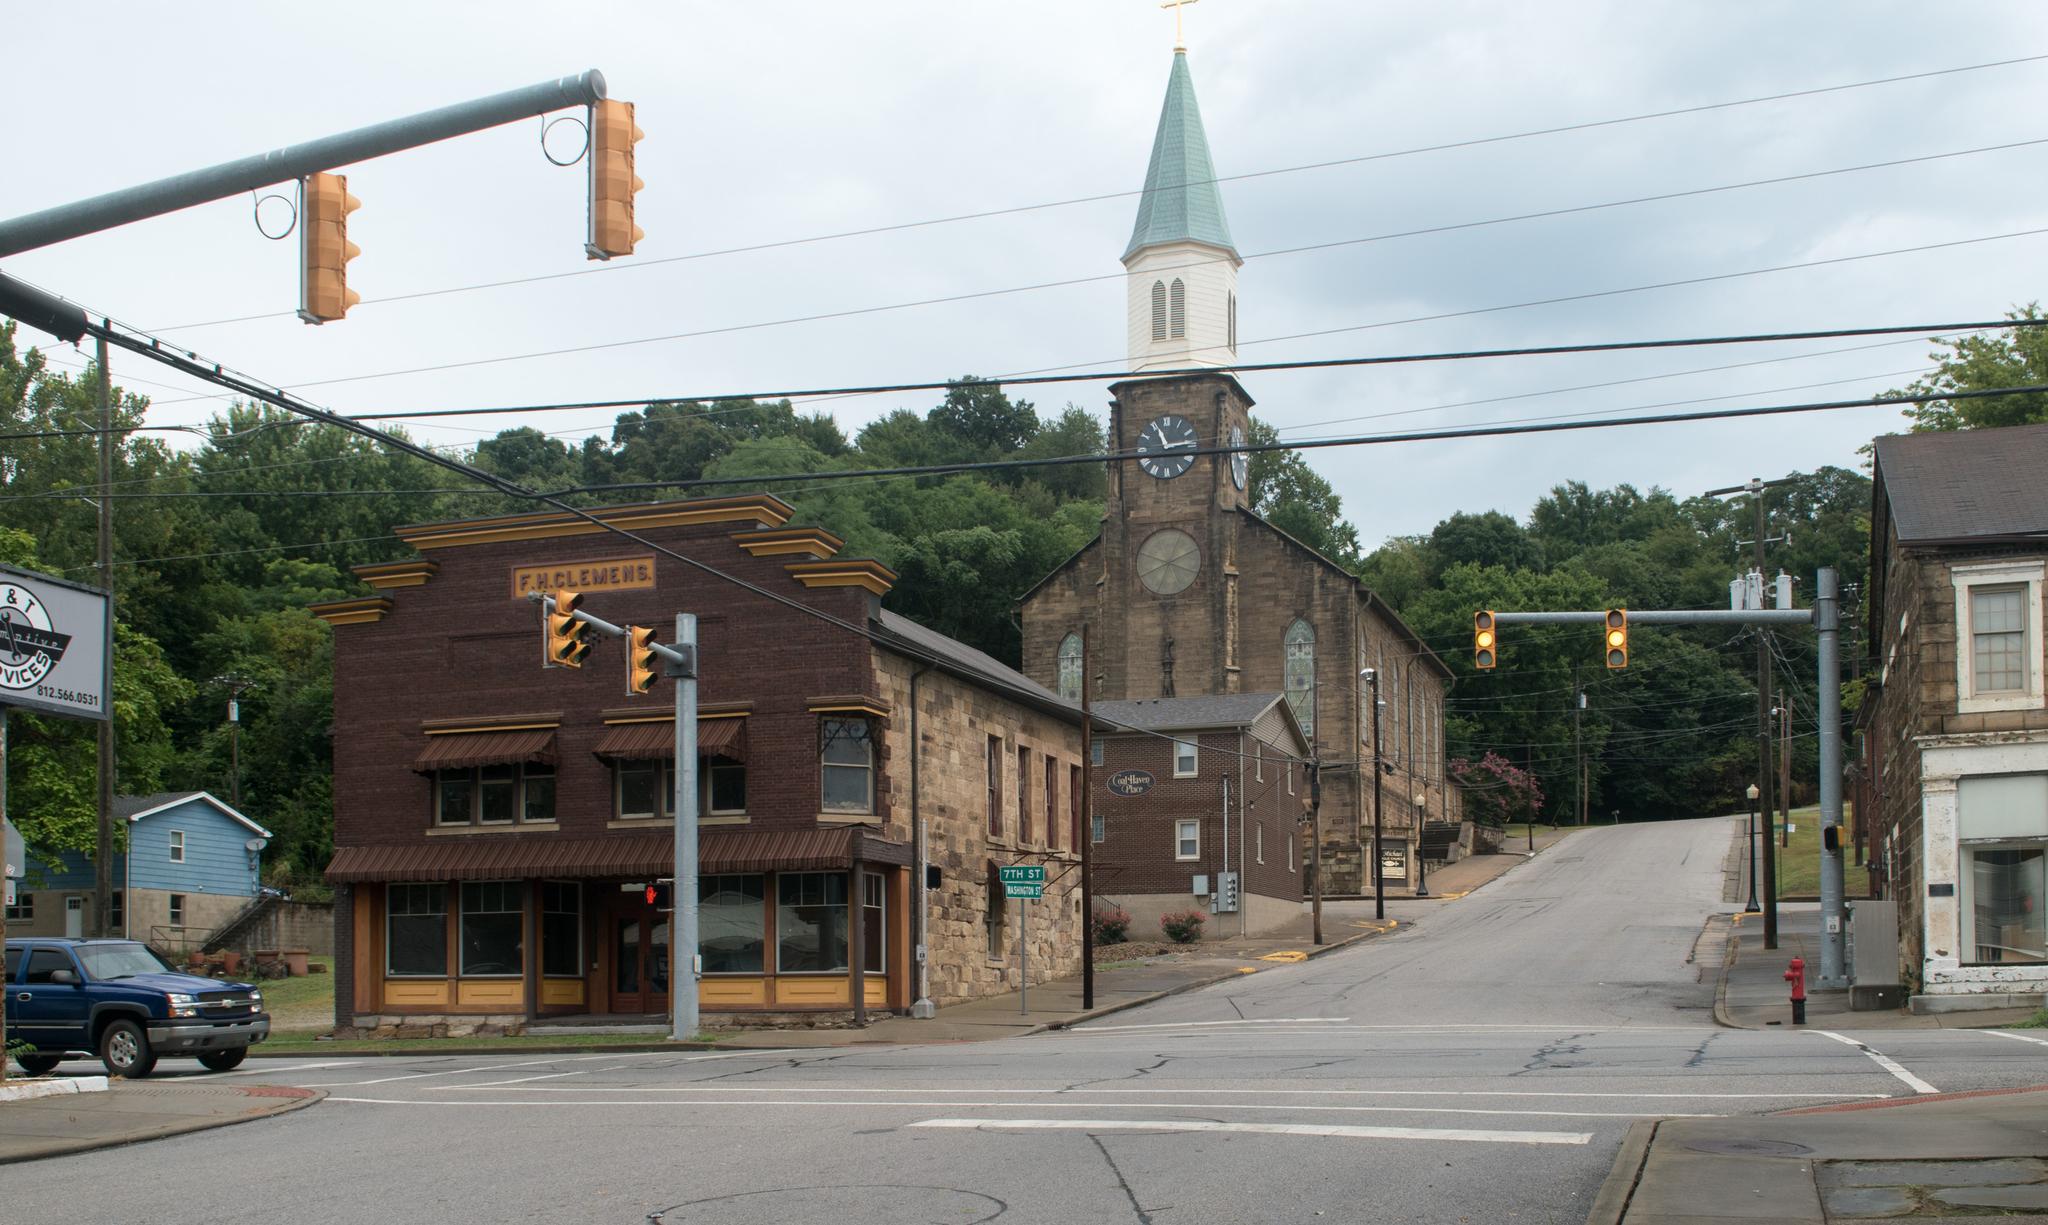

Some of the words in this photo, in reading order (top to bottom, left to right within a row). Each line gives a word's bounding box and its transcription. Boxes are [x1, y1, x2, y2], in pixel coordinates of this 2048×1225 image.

[24, 598, 35, 613] T
[37, 685, 98, 705] 812.566.0531
[1003, 869, 1024, 879] 7TH
[1028, 869, 1041, 879] ST
